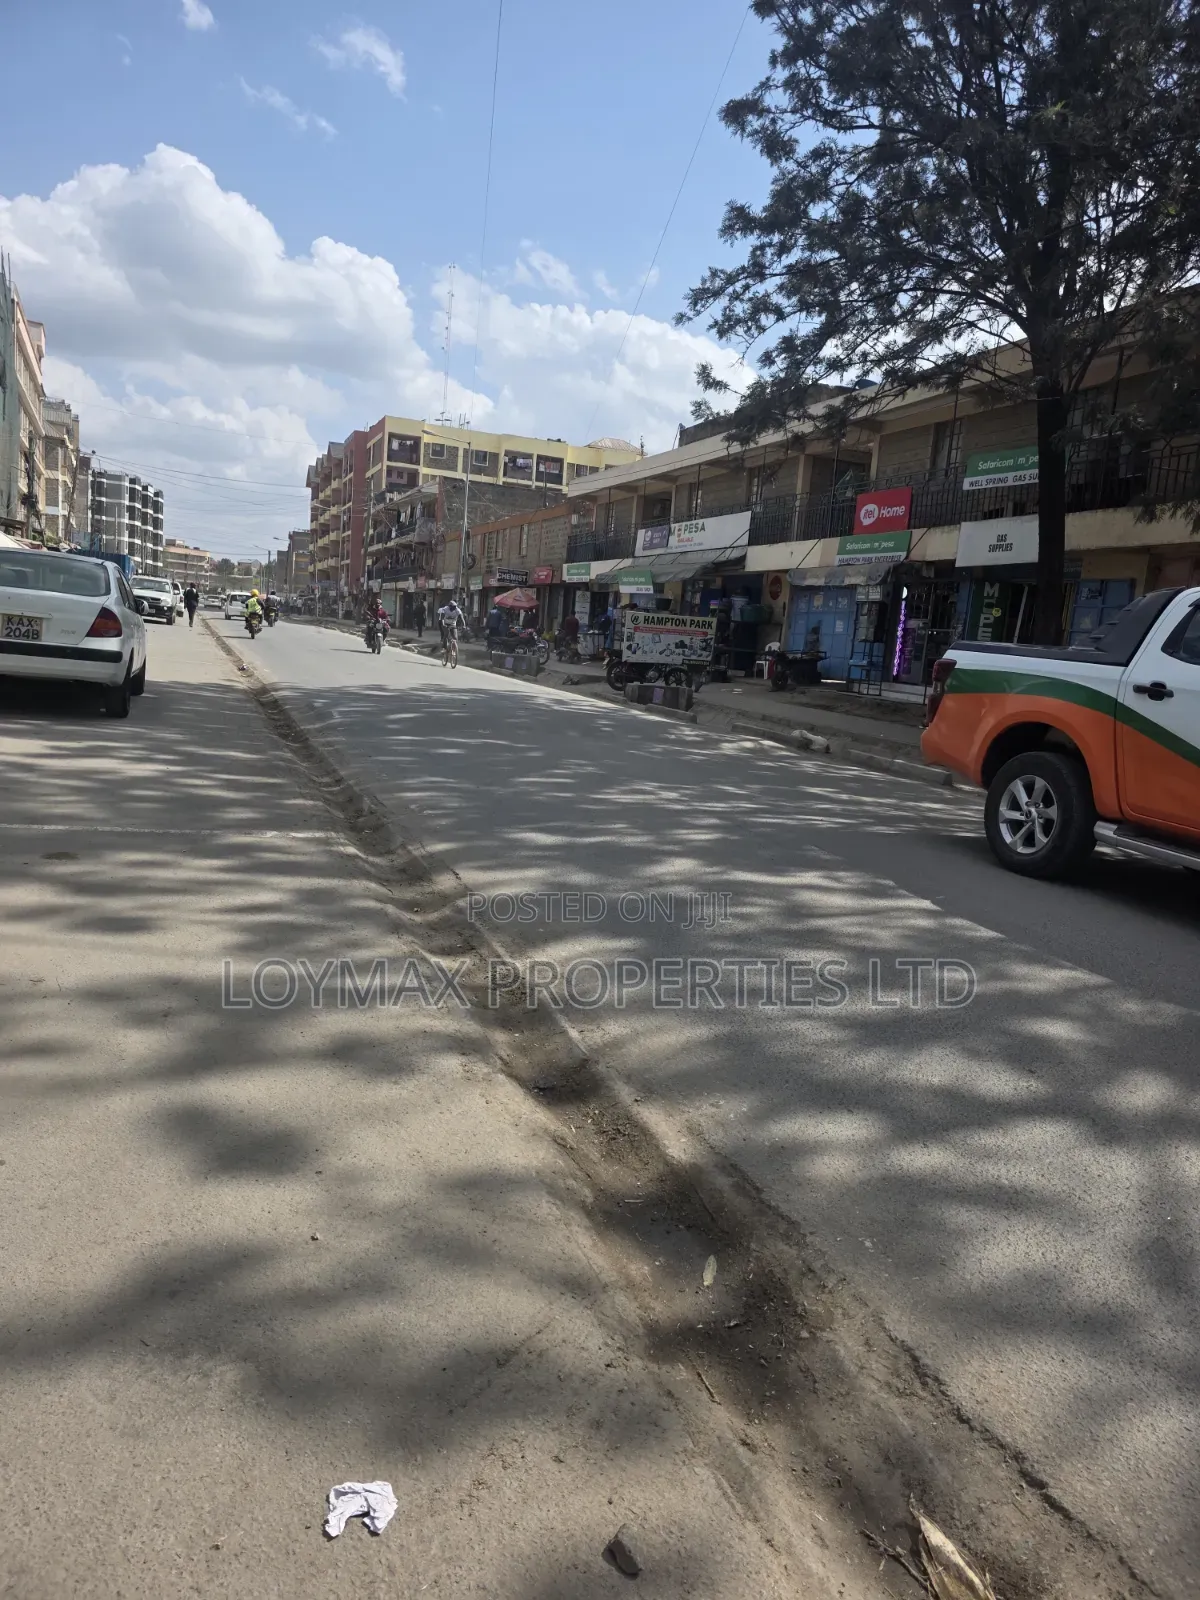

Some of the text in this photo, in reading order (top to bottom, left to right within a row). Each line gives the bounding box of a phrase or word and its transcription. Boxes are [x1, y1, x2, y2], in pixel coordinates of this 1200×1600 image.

[978, 458, 1014, 470] Safaricom
[968, 480, 983, 488] WELL
[985, 476, 1009, 486] SPRING
[1012, 474, 1027, 483] GAS
[863, 505, 905, 520] itel Home
[683, 522, 706, 535] PESA
[988, 534, 1013, 553] GAS SUPPLIES
[497, 573, 527, 582] CHEMIST
[6, 616, 34, 628] KAX
[643, 615, 687, 627] HAMPTON
[689, 619, 713, 630] PARK
[5, 627, 39, 640] 204B
